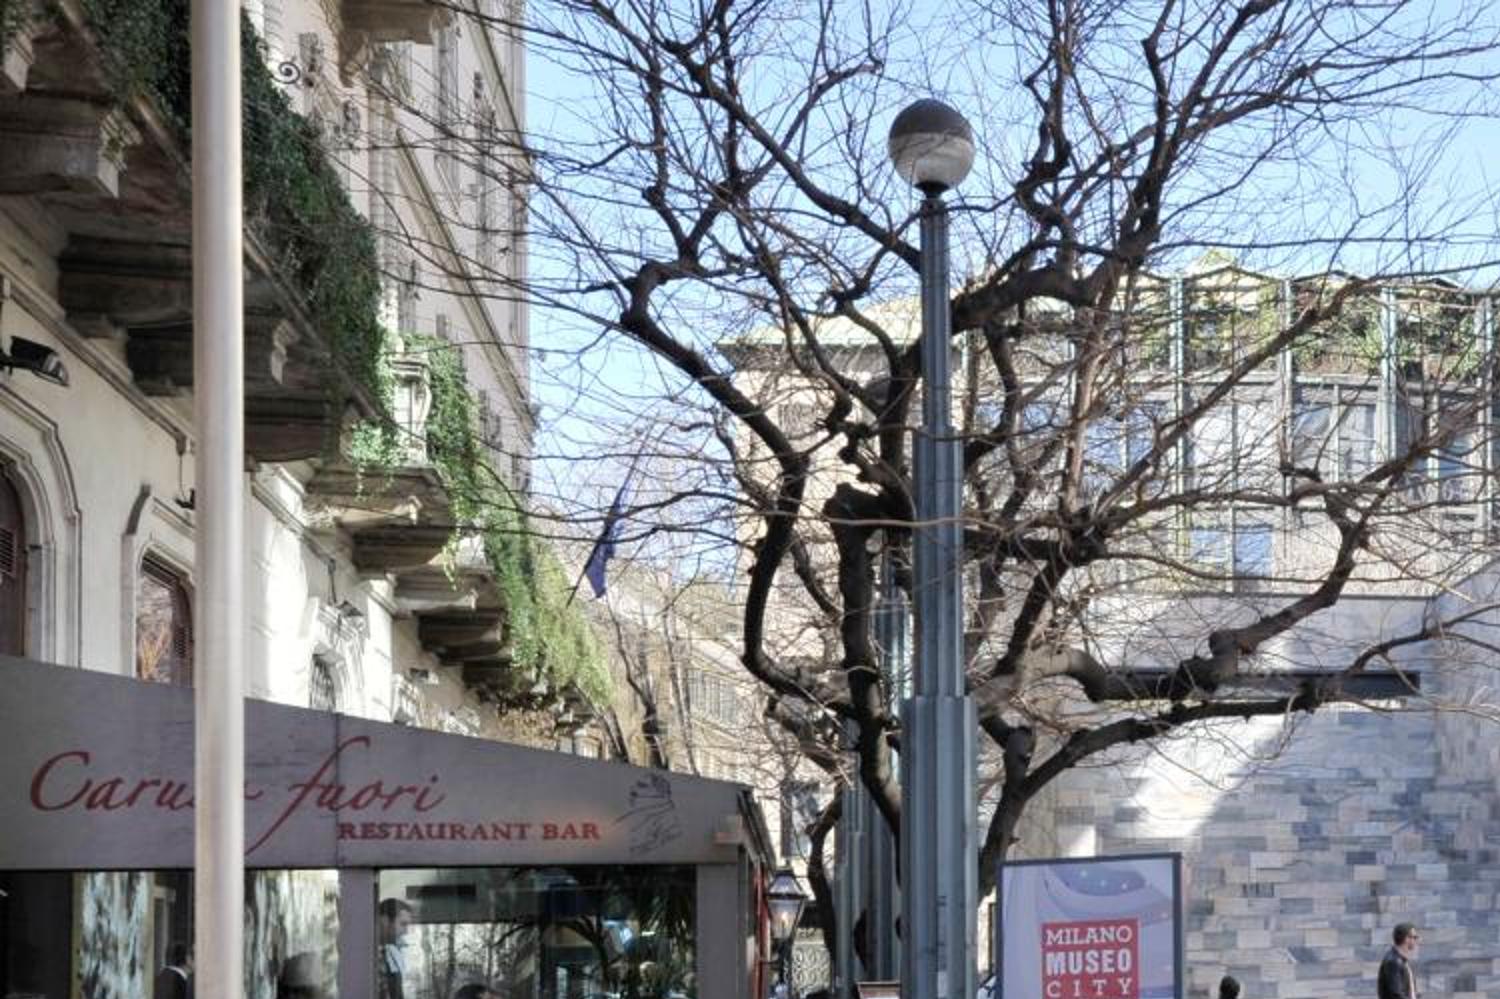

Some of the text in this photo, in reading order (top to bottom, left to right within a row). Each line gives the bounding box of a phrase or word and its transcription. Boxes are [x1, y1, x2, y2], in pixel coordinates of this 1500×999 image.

[30, 735, 446, 857] Caru fuori
[336, 822, 602, 841] RESTAURANT BAR
[1045, 924, 1133, 945] MILANO
[1045, 947, 1132, 976] MUSEO
[1046, 977, 1133, 997] CITY
